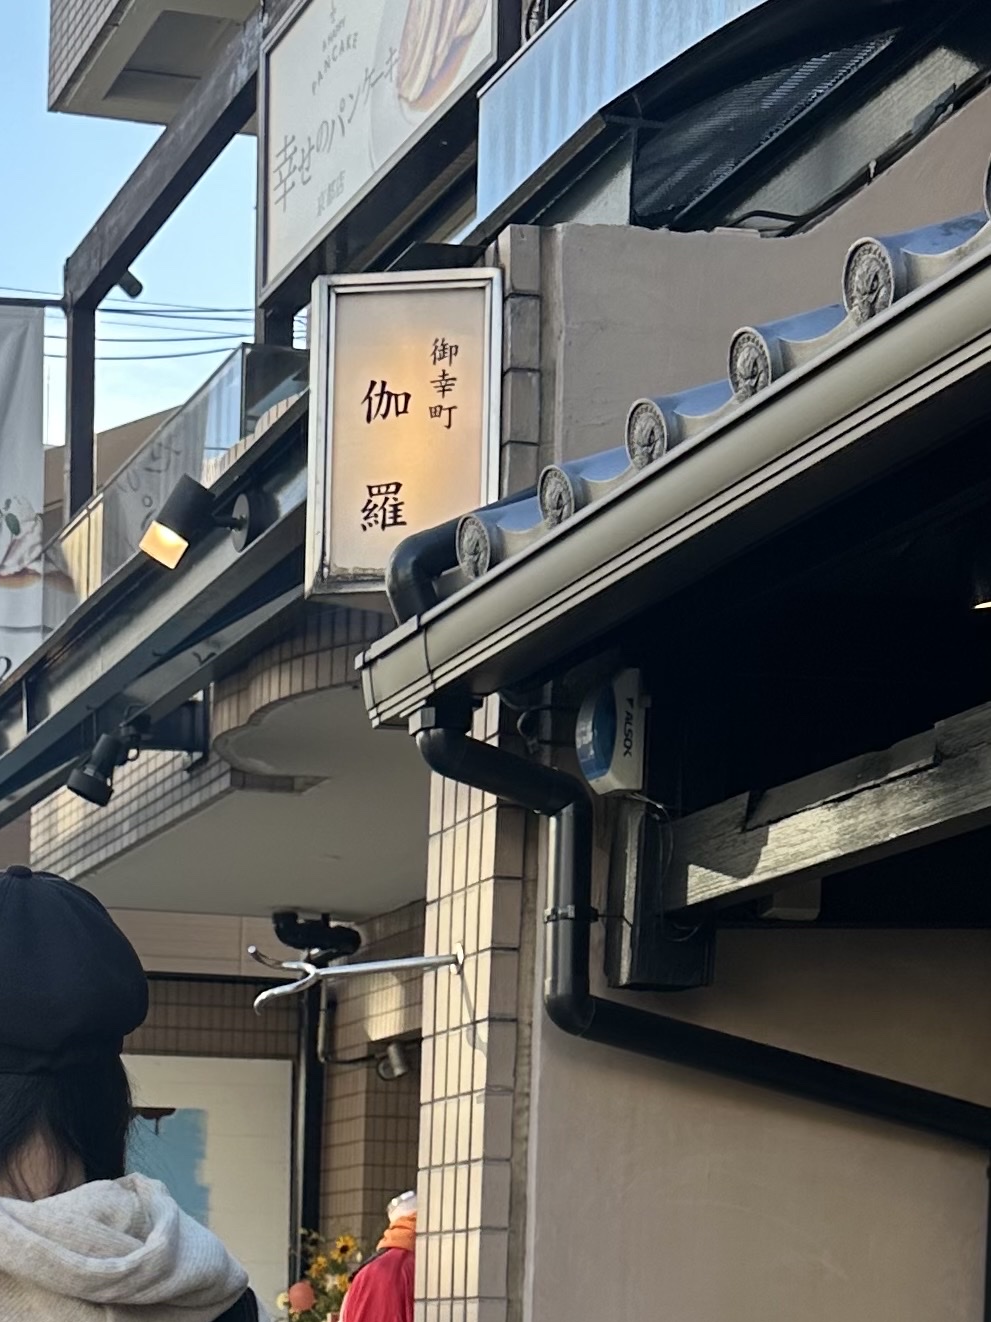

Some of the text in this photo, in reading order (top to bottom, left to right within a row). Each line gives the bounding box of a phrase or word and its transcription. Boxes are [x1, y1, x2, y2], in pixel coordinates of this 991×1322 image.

[311, 31, 358, 96] PANCAKE
[273, 46, 399, 213] 幸せのパンケーキ
[429, 337, 460, 431] 御幸町
[360, 378, 412, 532] 伽羅
[623, 710, 634, 758] ALSOK
